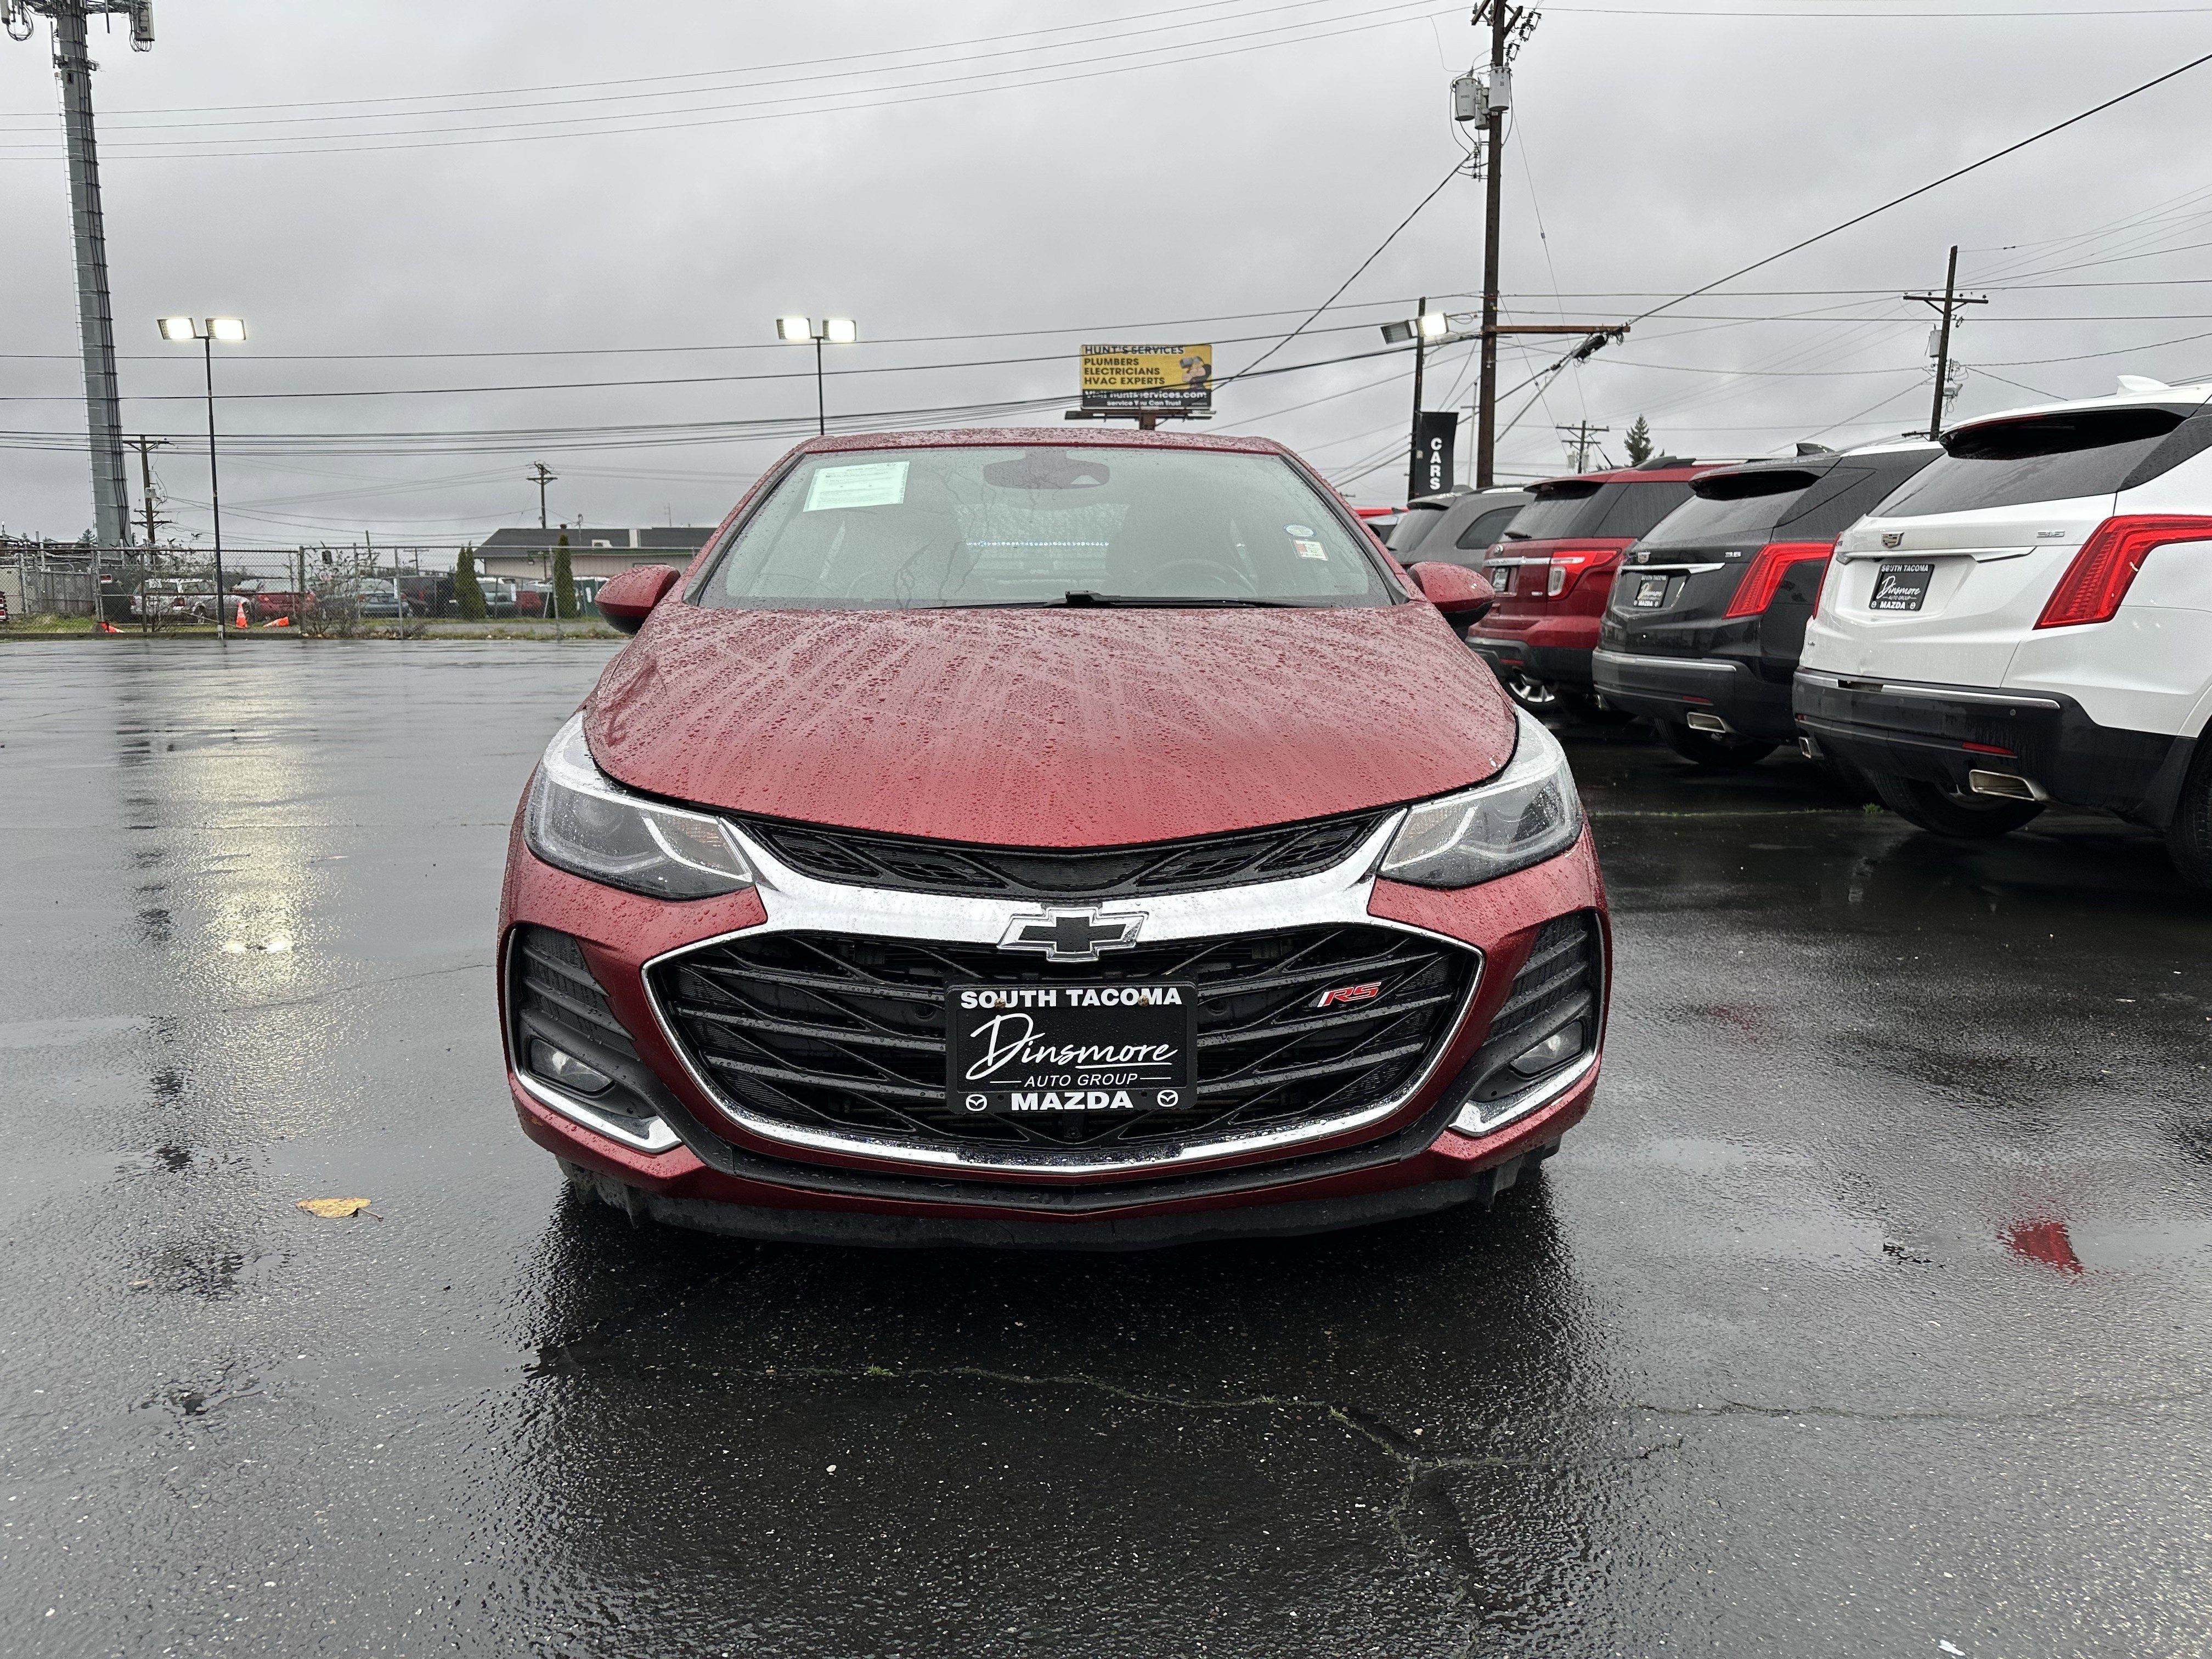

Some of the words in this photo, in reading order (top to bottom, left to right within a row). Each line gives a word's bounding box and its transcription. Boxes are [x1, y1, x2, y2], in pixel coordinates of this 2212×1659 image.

[1085, 345, 1128, 354] HUNT'S
[1131, 345, 1184, 354] SERVICES
[1084, 358, 1139, 366] PLUMBERS
[1084, 367, 1160, 375] ELECTRICIANS
[1429, 437, 1443, 490] CARS
[1876, 575, 1921, 599] Dinsmore
[1880, 601, 1906, 609] MAZDA
[961, 989, 1057, 1009] SOUTH
[1066, 987, 1182, 1007] TACOMA
[1317, 981, 1382, 1008] RS
[965, 1012, 1178, 1080] Dinsmore
[1024, 1075, 1071, 1088] AUTO
[1077, 1073, 1138, 1086] GROUP
[1011, 1090, 1134, 1110] MAZDA
